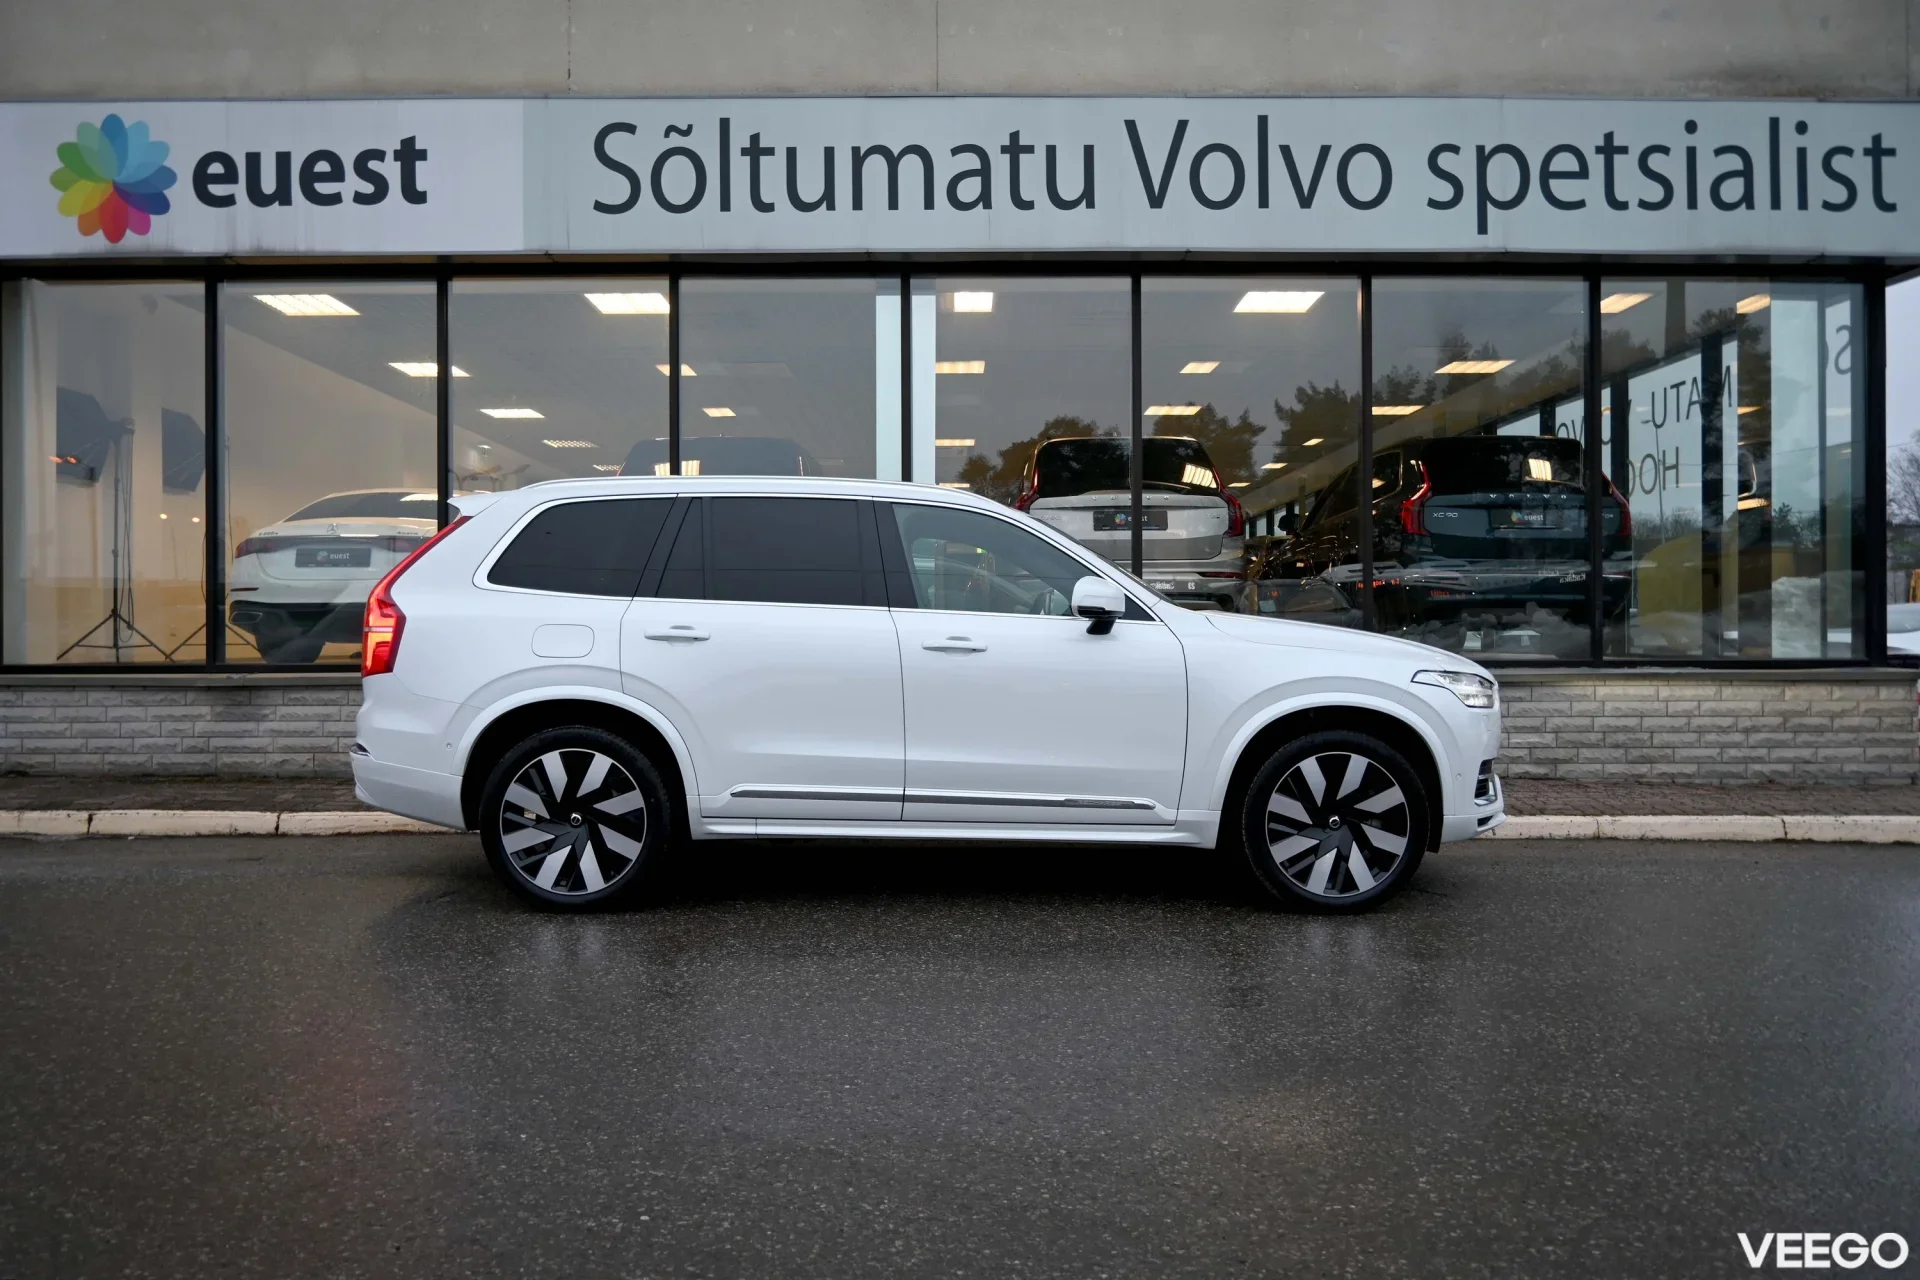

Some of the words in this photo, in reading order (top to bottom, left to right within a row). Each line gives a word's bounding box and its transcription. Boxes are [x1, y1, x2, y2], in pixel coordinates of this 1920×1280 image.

[193, 136, 428, 208] euest
[593, 118, 1096, 215] Sõltumatu
[1124, 115, 1393, 210] Volvo
[1427, 117, 1898, 236] spetsialist
[1127, 514, 1148, 522] est
[1524, 513, 1544, 521] euest
[329, 552, 351, 560] euest
